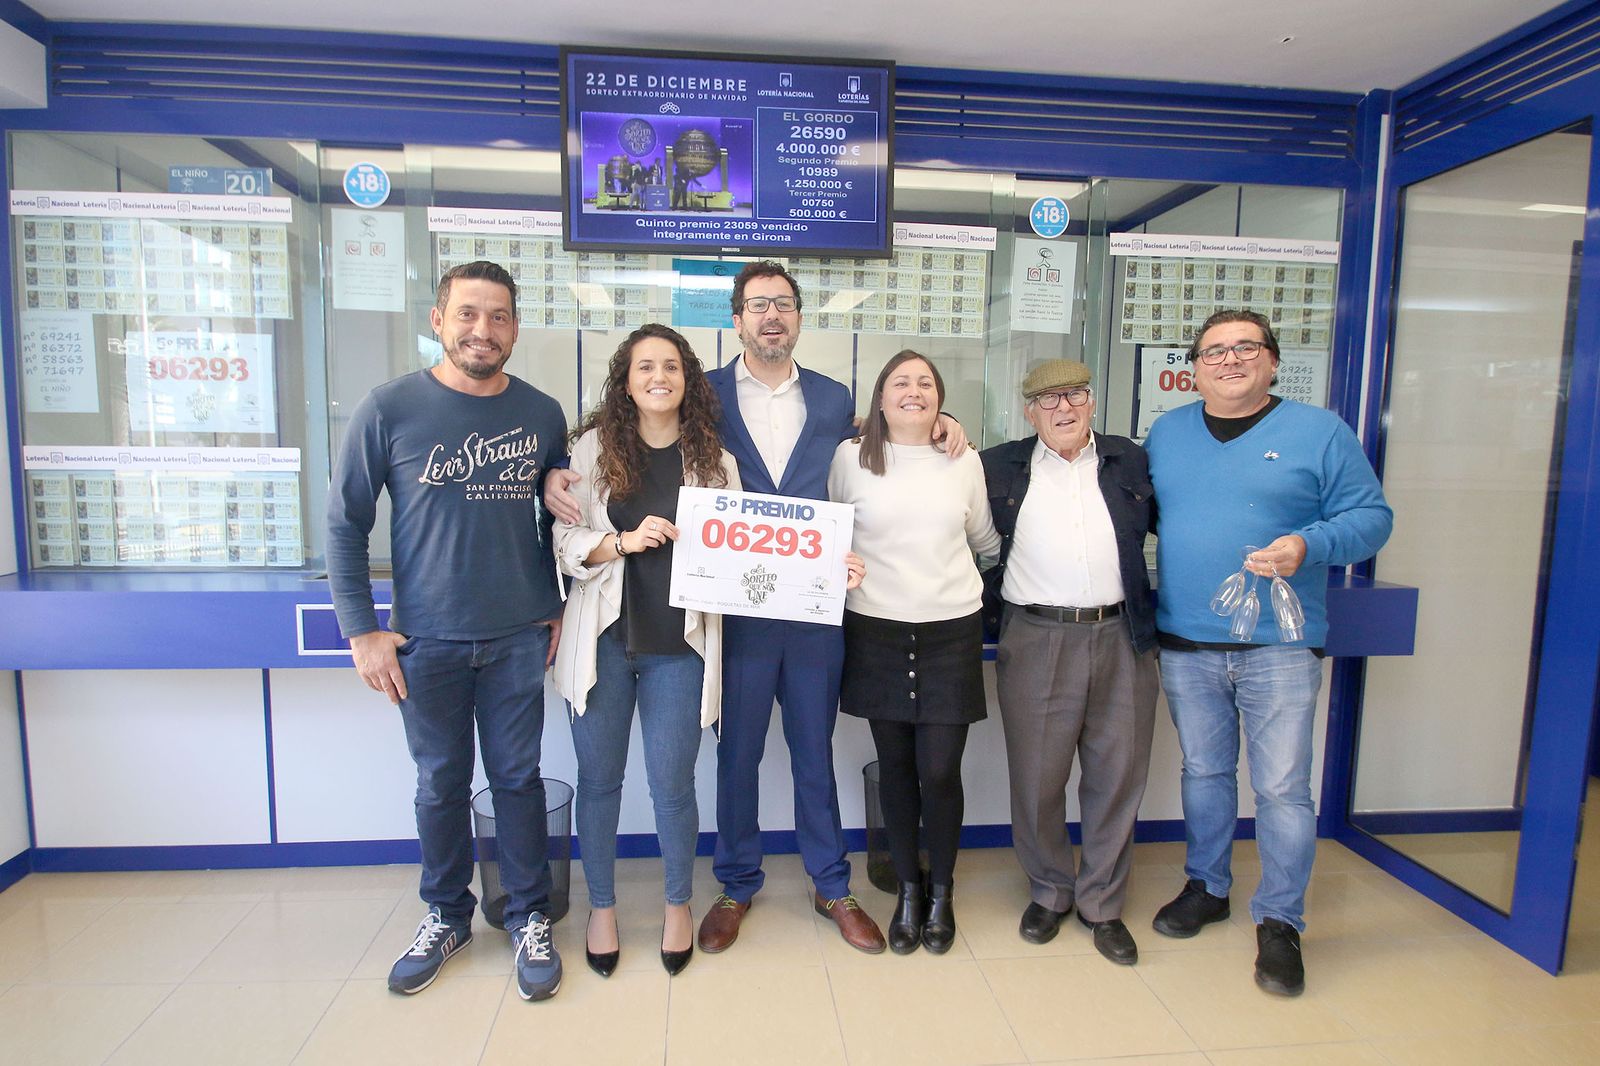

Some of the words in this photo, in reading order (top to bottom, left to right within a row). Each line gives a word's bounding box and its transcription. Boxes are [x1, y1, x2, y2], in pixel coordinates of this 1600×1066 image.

[586, 72, 606, 86] 22
[616, 74, 638, 87] DE
[648, 75, 747, 92] DICIEMBRE
[586, 88, 618, 96] SORTEO
[622, 90, 694, 99] EXTRAORDINARIO
[712, 94, 748, 102] NAVIDAD
[784, 112, 800, 122] EL
[804, 113, 854, 124] GORDO
[790, 126, 846, 140] 26590
[776, 142, 847, 156] 4.000.000
[851, 145, 860, 156] €
[778, 156, 822, 165] Segundo
[824, 158, 858, 166] Premio
[172, 169, 183, 178] EL
[185, 168, 208, 178] NIÑO
[798, 166, 838, 177] 10989
[349, 173, 380, 192] +18
[784, 179, 842, 188] 1.250.000
[845, 181, 853, 190] €
[818, 190, 848, 198] Premio
[802, 198, 834, 207] 00750
[789, 208, 836, 218] 500.000
[839, 210, 848, 219] €
[1034, 206, 1060, 224] +18
[636, 218, 676, 228] Quinto
[680, 220, 720, 231] premio
[724, 221, 758, 230] 23059
[761, 222, 808, 232] vendido
[752, 232, 791, 242] Girona
[40, 332, 81, 342] 69241
[42, 344, 82, 352] 86372
[42, 355, 83, 364] 58563
[1166, 352, 1182, 364] 5º
[42, 366, 84, 376] 71697
[150, 356, 249, 382] 06293
[1280, 366, 1313, 374] 69241
[1280, 376, 1312, 384] 86372
[1279, 386, 1312, 394] 58563
[454, 427, 538, 482] Strauss
[499, 462, 516, 482] &
[466, 484, 485, 492] SAN
[715, 495, 737, 512] 5º
[741, 498, 815, 522] PREMIO
[701, 518, 823, 559] 06293
[740, 572, 778, 587] SORTEO
